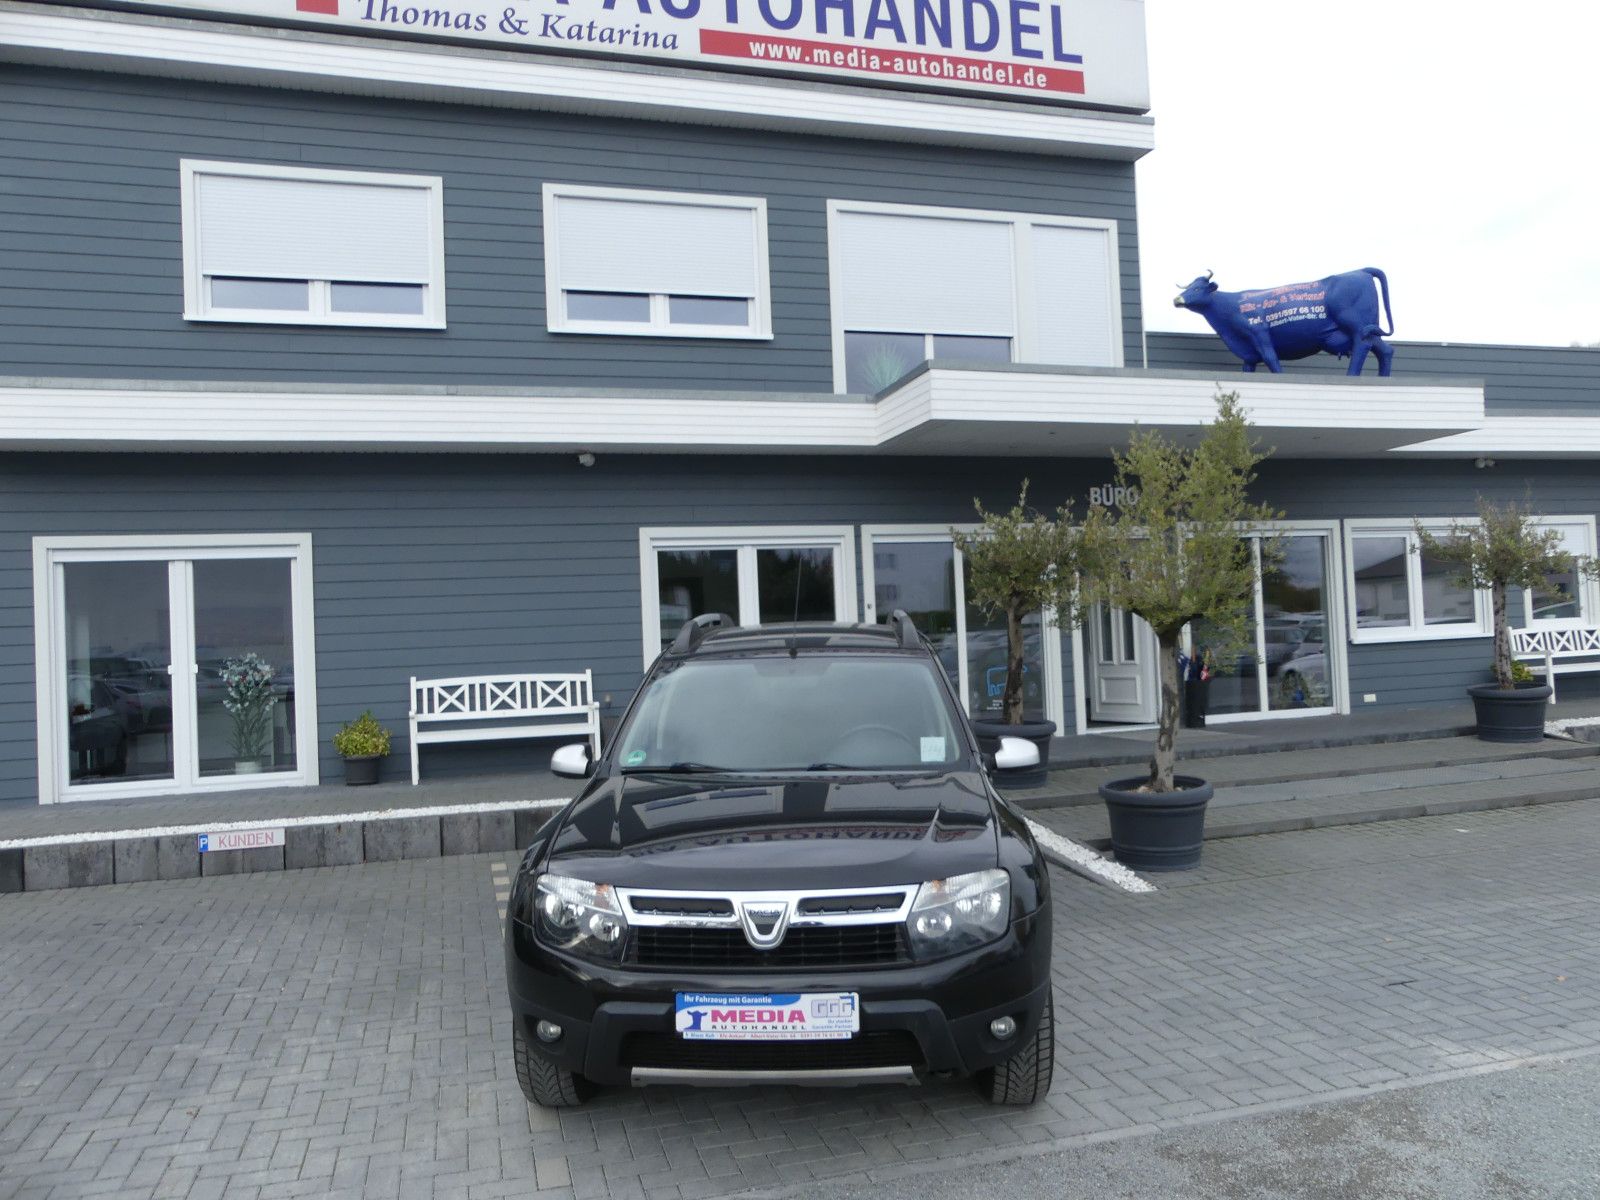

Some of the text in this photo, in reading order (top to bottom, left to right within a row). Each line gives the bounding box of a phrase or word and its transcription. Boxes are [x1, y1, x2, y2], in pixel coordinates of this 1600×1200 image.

[358, 0, 680, 51] Thomas & Katarina
[602, 0, 1084, 65] OHANDEL
[749, 40, 1048, 88] www.media-autohandel.de
[1248, 316, 1263, 325] Tel.
[1311, 305, 1325, 313] 100
[200, 831, 275, 849] P KUNDEN
[684, 994, 772, 1004] Ihr Fahrzeug mit Garantie
[711, 1009, 806, 1023] MEDIA
